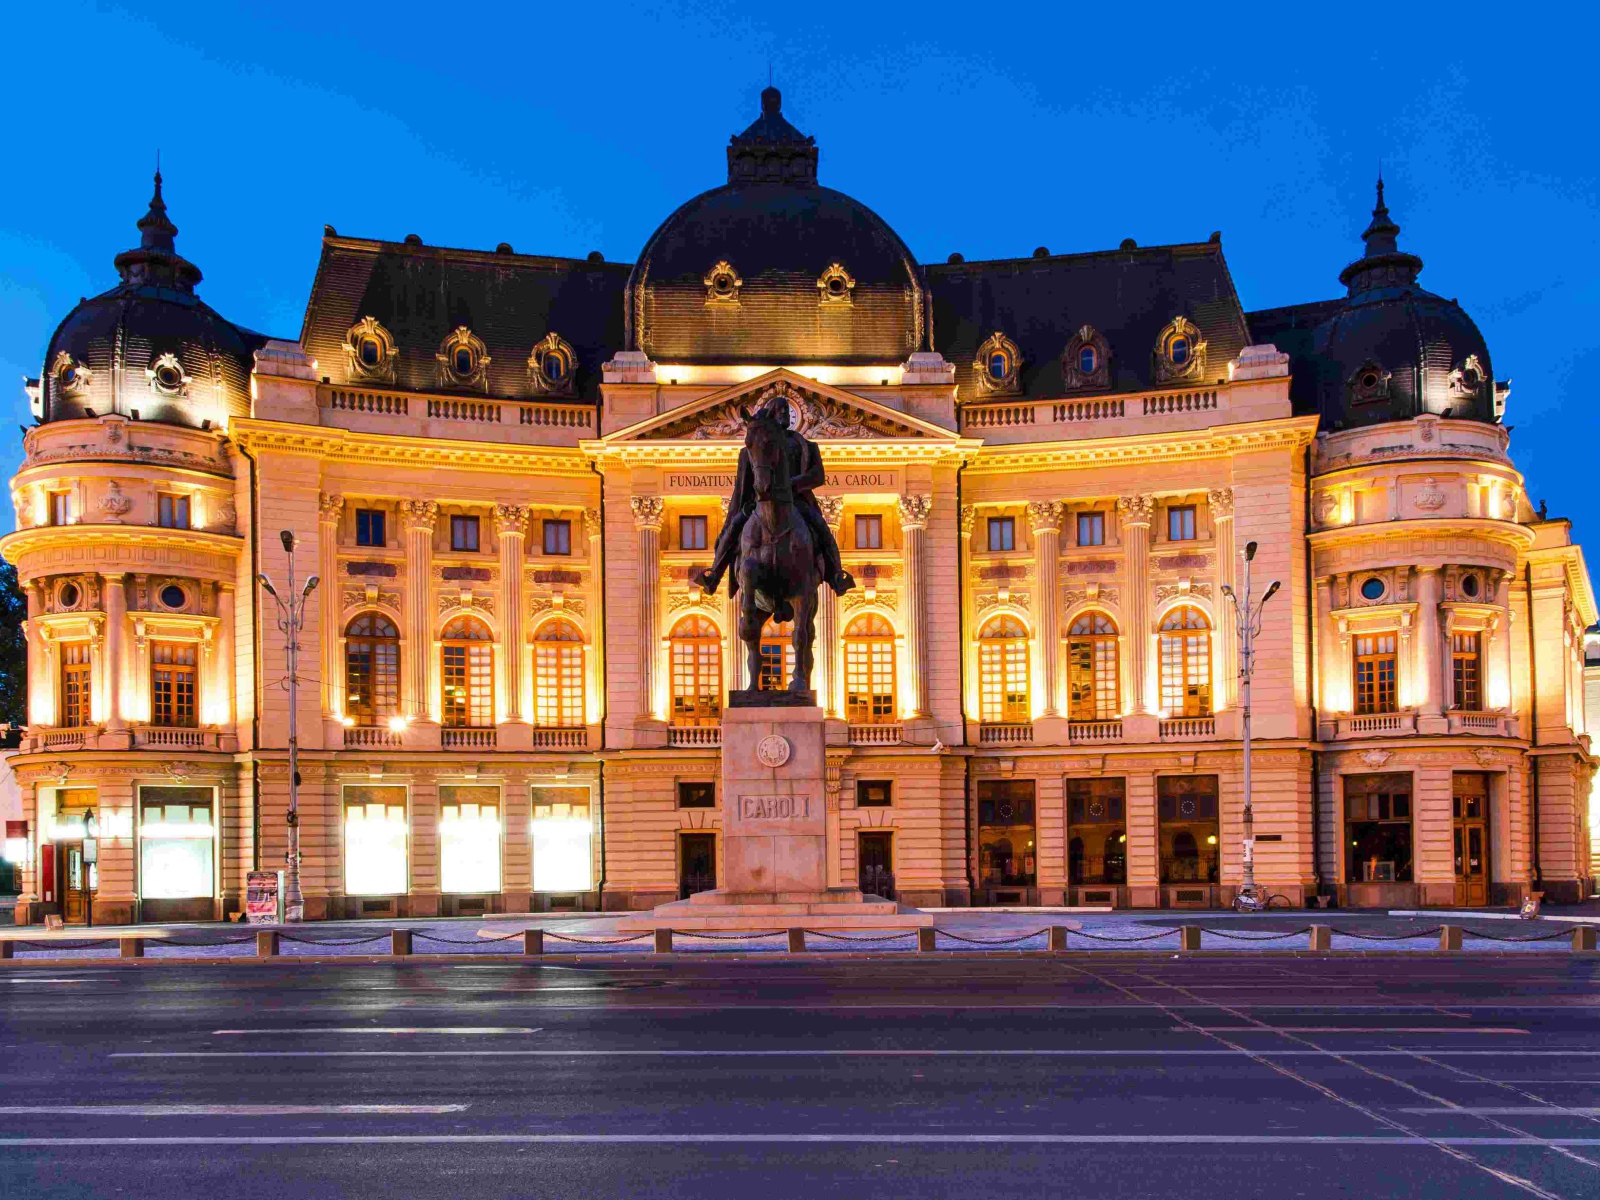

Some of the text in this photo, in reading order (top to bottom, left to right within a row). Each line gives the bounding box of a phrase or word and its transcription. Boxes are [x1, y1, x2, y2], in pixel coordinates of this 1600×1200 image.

[845, 474, 884, 486] CAROL
[889, 474, 893, 486] I
[743, 797, 809, 819] CAROL I
